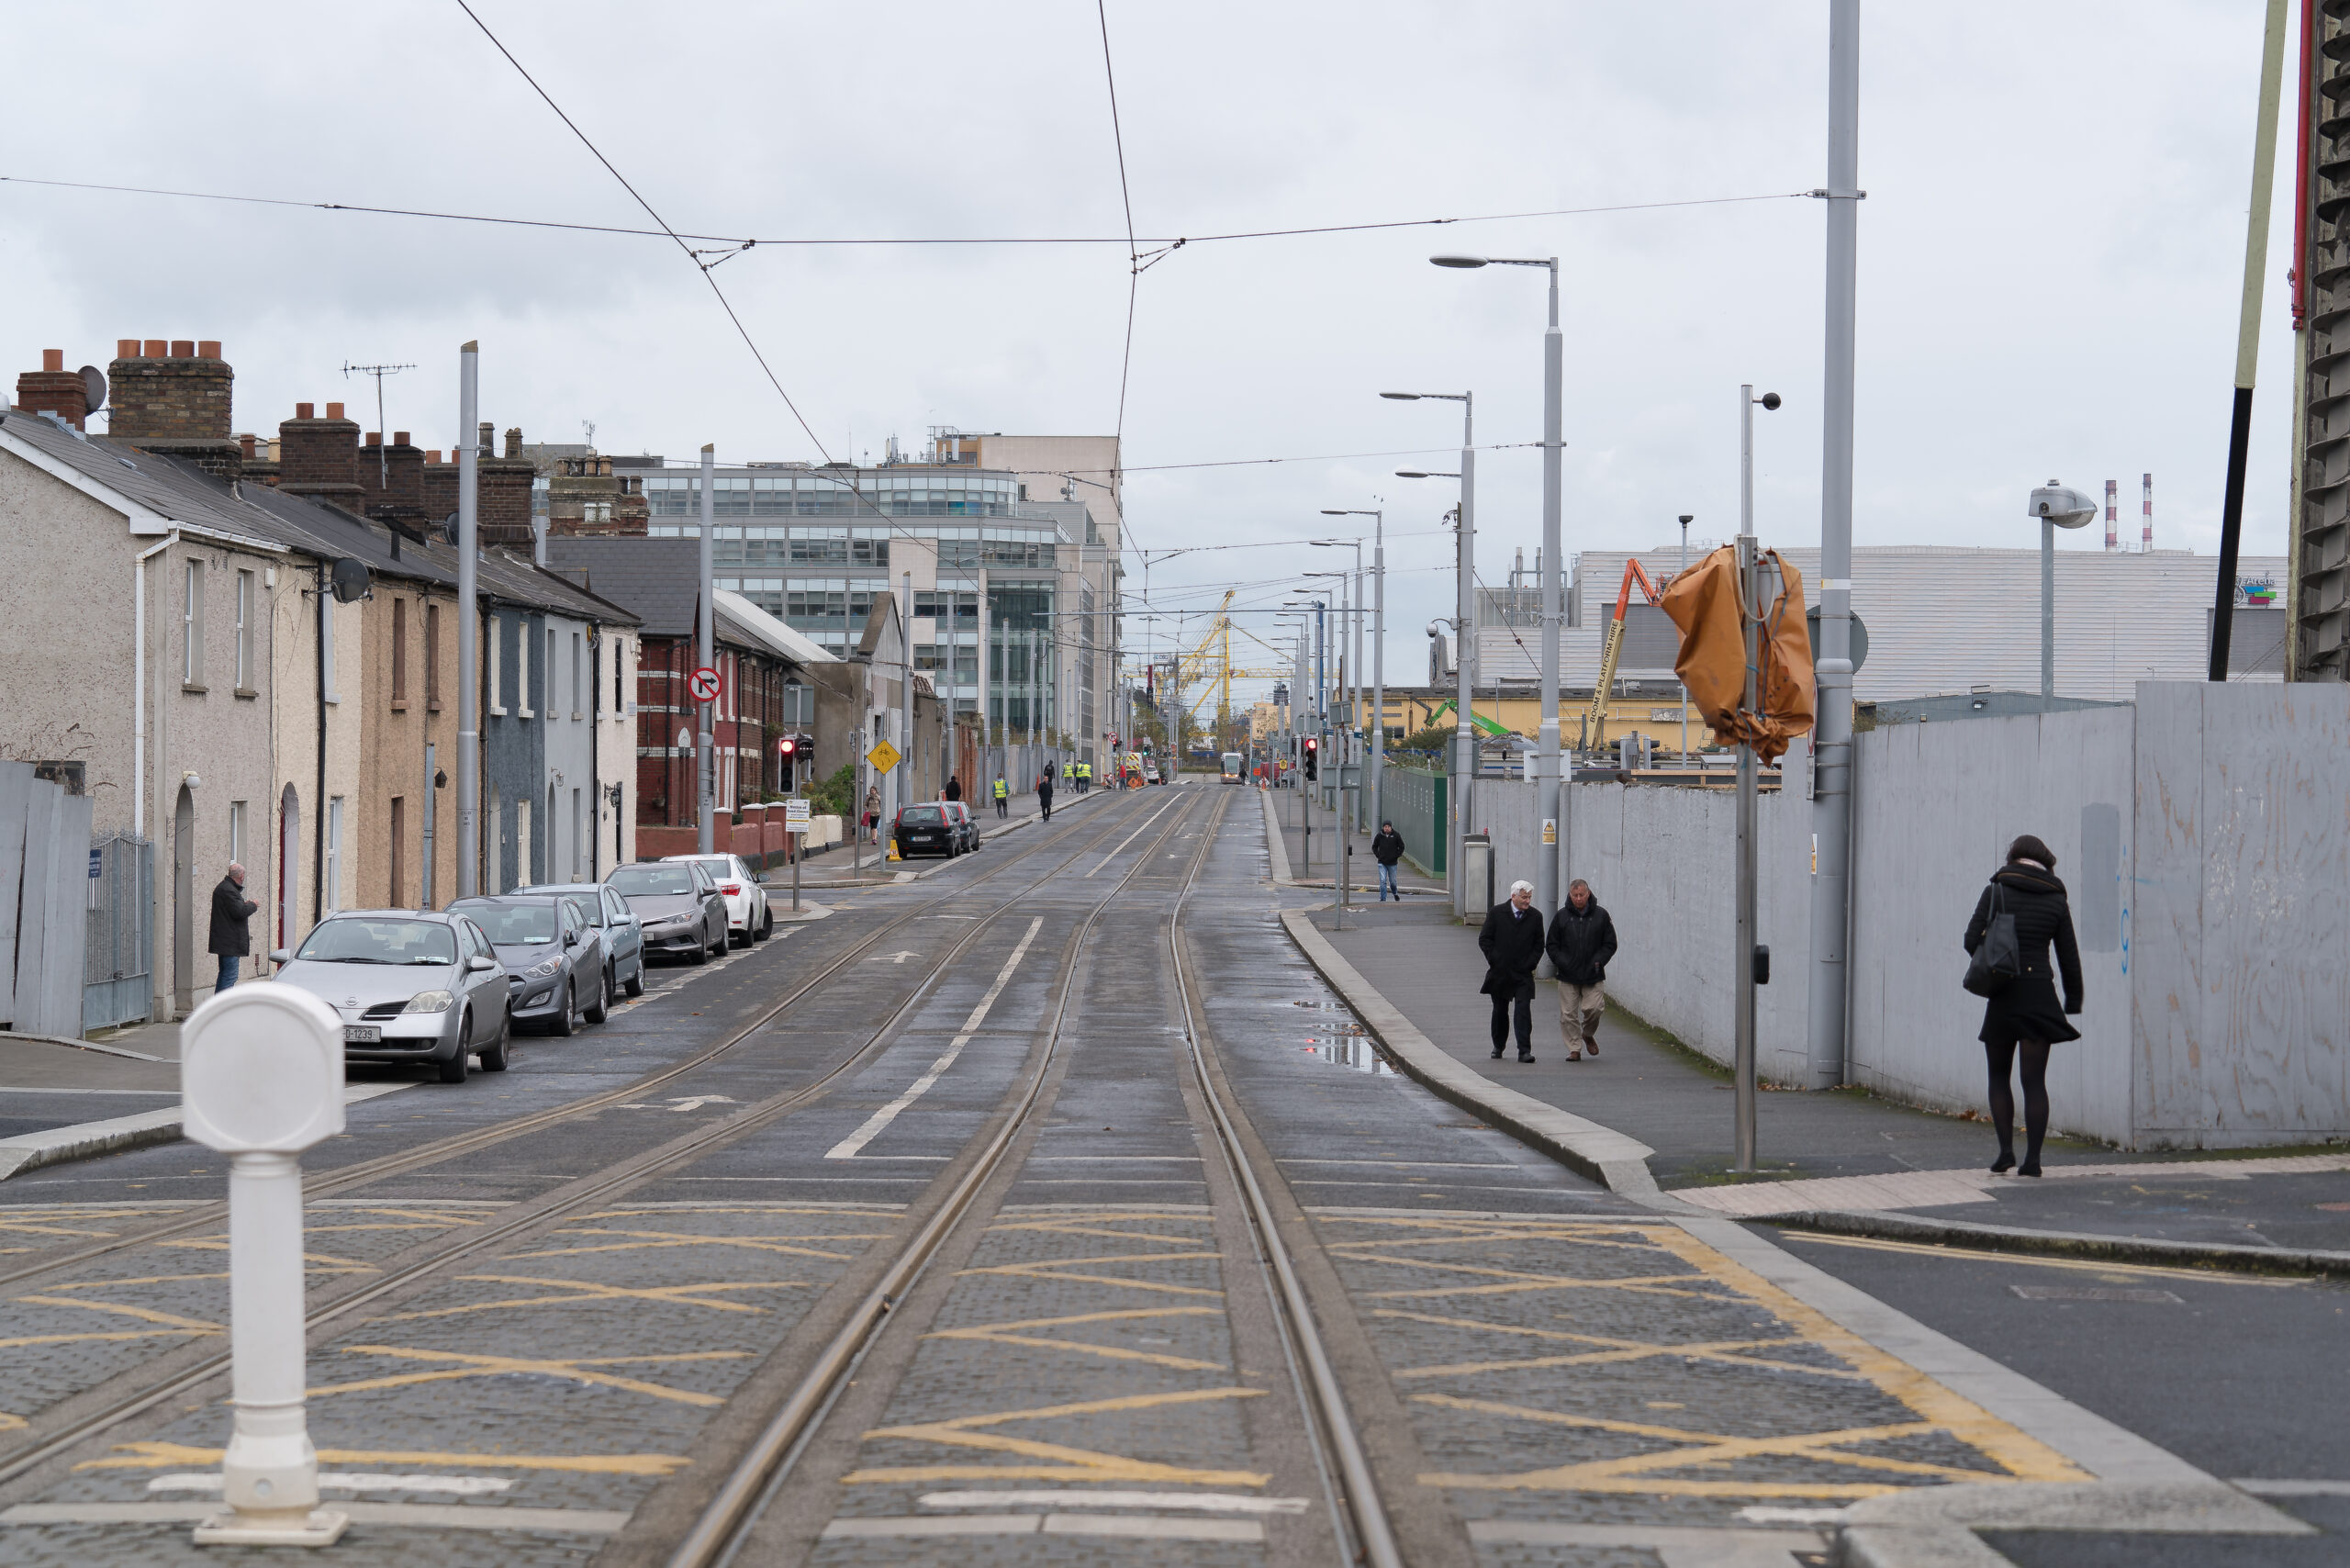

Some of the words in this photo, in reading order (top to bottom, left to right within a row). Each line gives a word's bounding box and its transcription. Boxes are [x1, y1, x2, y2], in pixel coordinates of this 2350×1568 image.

[2246, 577, 2277, 585] Arena
[1589, 696, 1600, 723] BOOM
[1597, 643, 1613, 688] PLATFORM
[1608, 621, 1618, 642] HIRE
